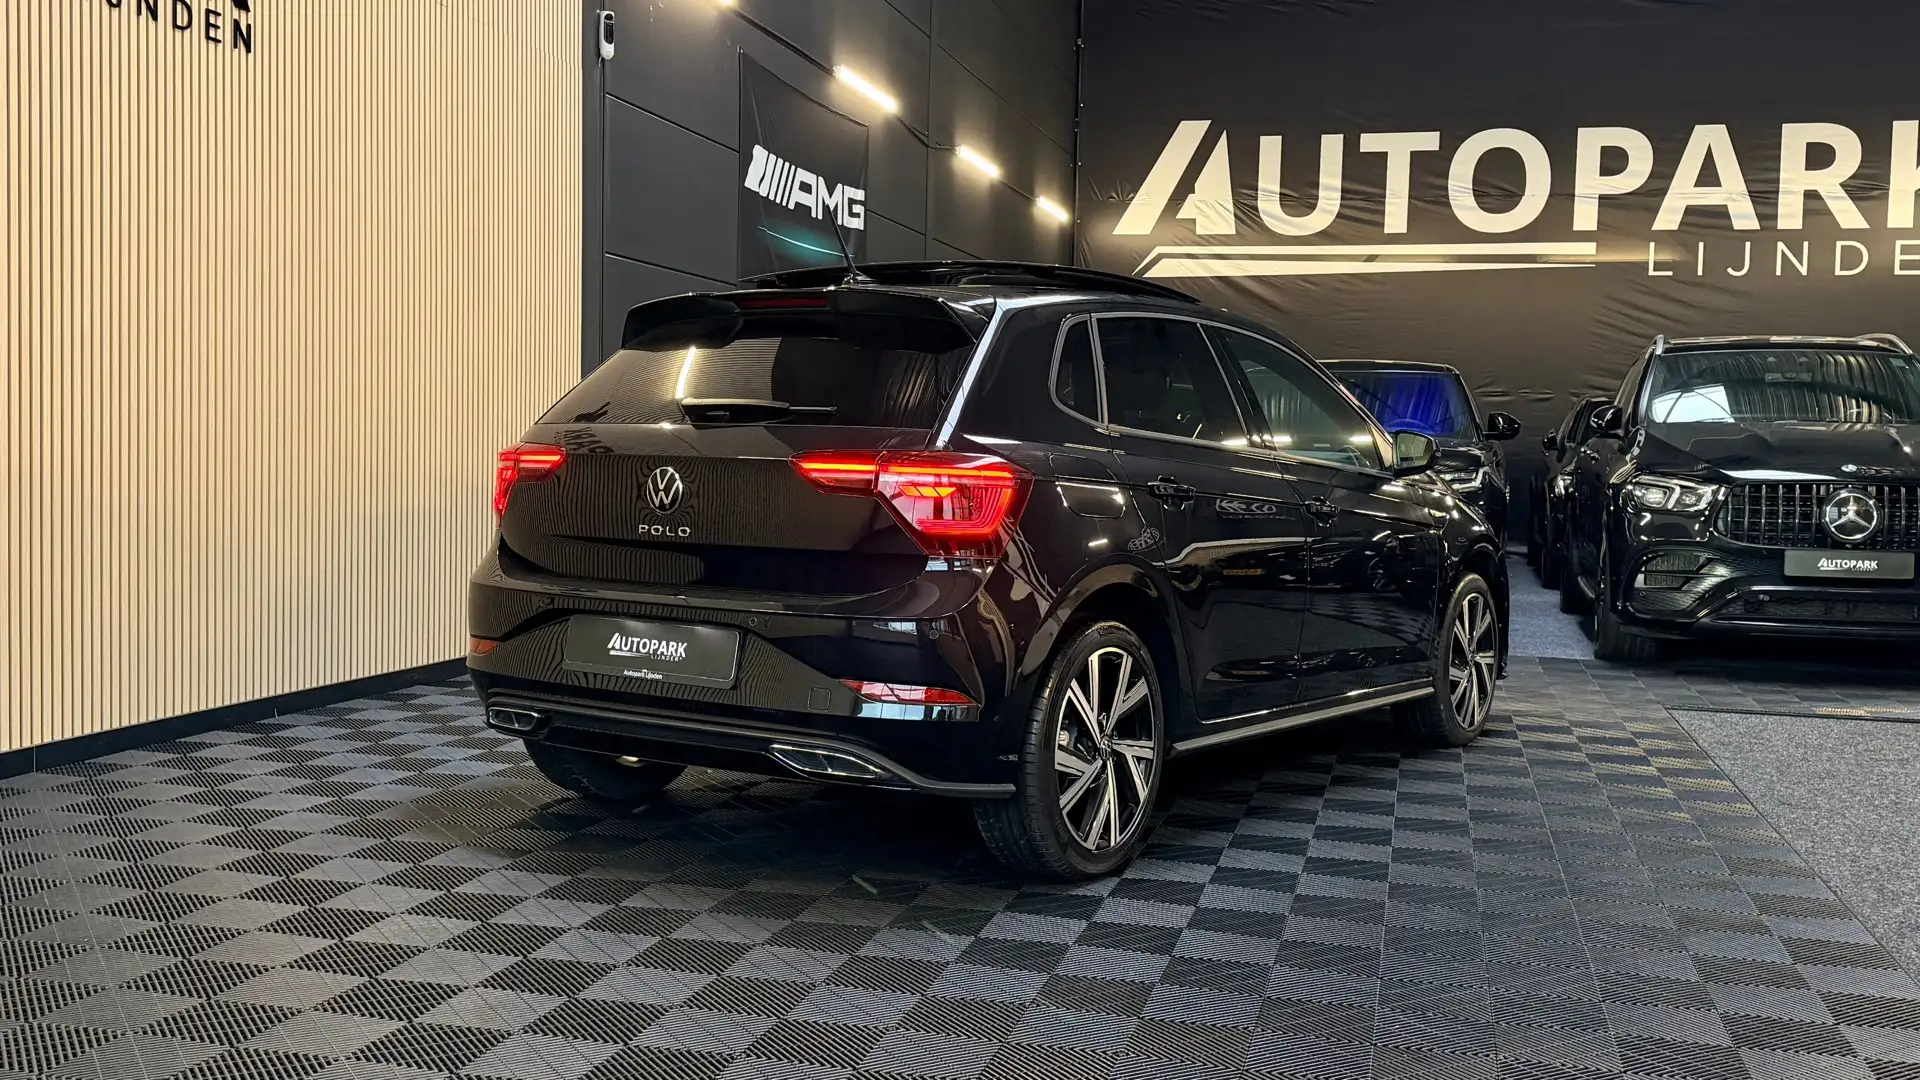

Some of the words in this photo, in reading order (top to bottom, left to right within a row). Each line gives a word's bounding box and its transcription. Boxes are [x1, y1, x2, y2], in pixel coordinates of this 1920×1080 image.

[784, 165, 866, 231] AMG
[638, 524, 691, 537] POLO
[1817, 557, 1878, 569] AUTOPARK
[607, 632, 688, 658] AUTOPARK
